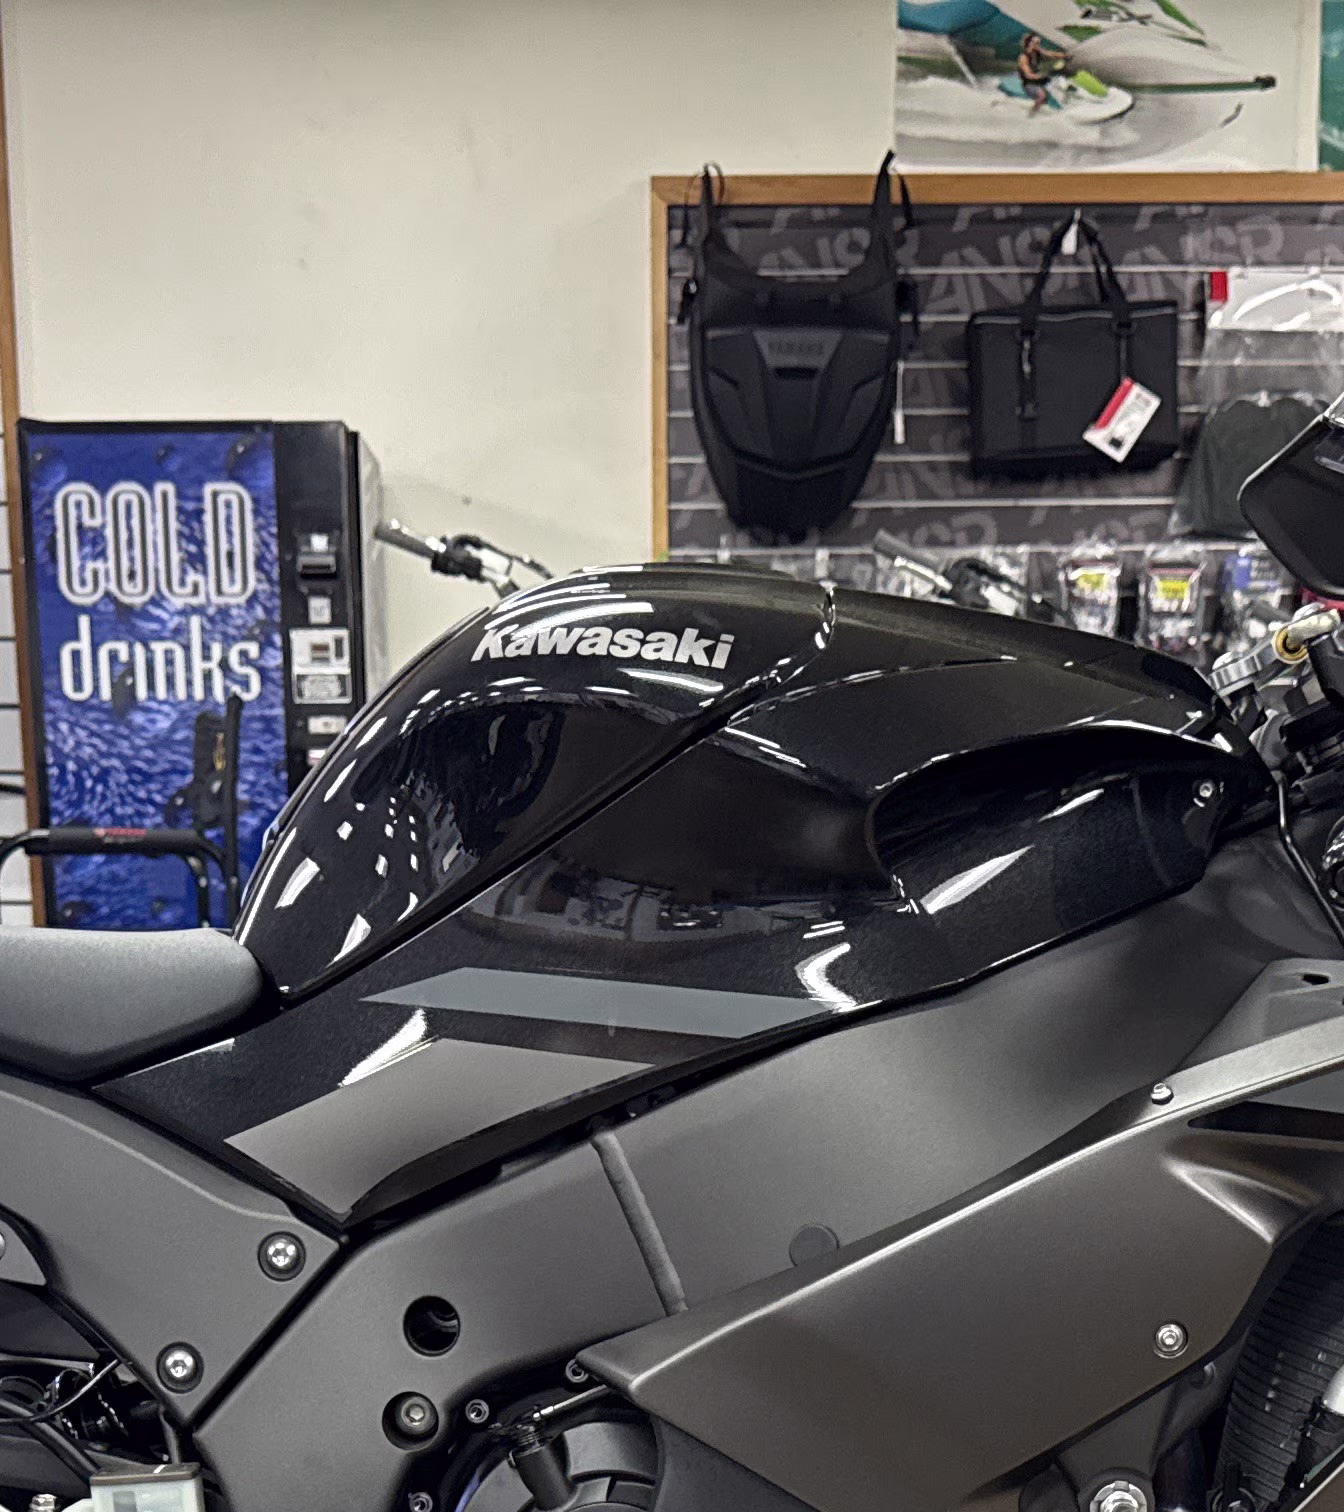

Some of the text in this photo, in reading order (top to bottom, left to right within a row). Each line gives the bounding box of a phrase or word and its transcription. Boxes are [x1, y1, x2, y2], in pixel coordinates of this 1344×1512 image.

[54, 481, 255, 605] COLD
[59, 615, 262, 702] drinks
[470, 627, 735, 670] Kawasaki
